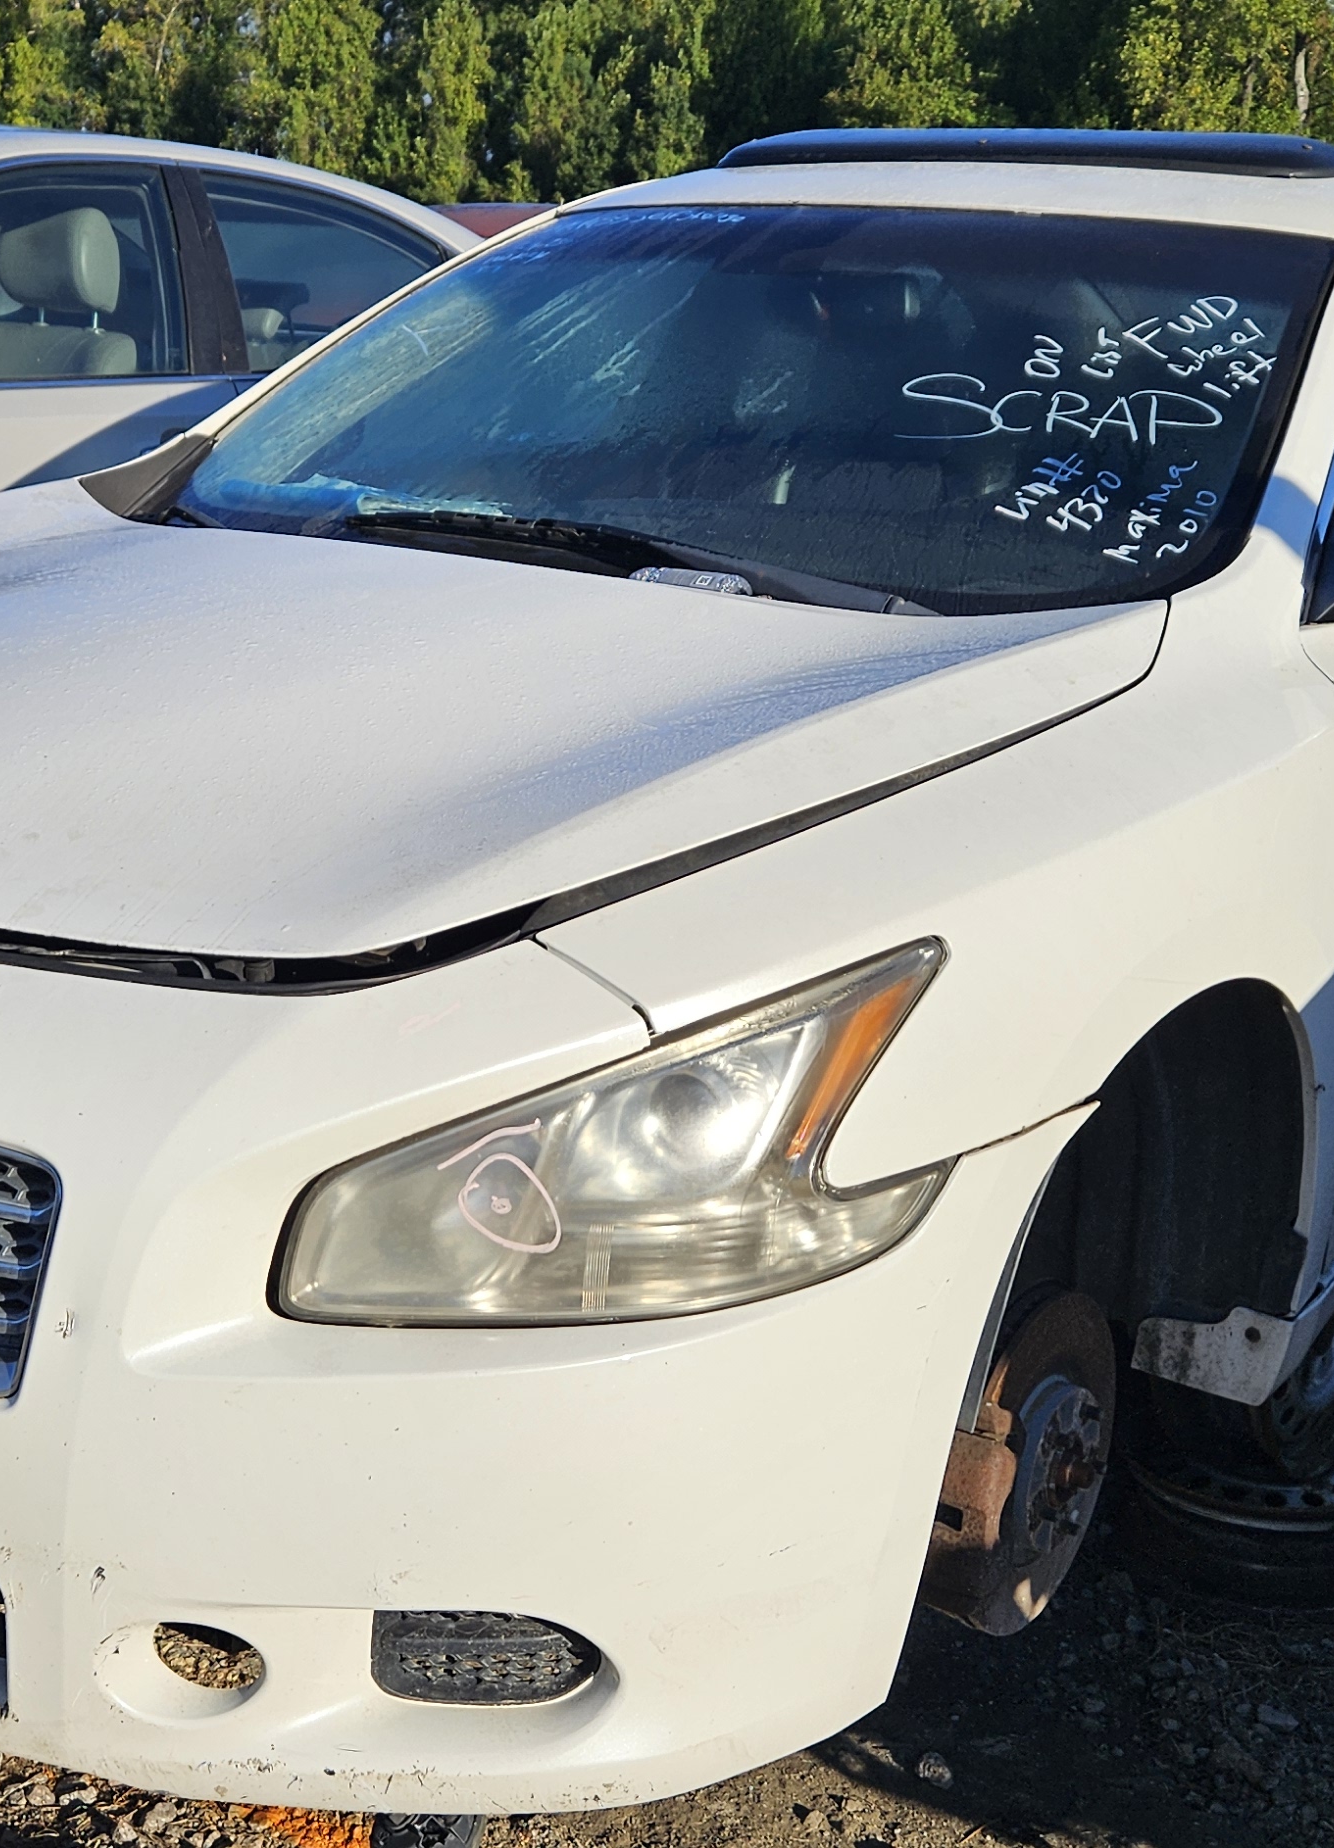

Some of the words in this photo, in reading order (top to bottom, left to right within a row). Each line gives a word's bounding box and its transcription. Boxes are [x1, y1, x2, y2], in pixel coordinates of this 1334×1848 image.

[1024, 335, 1064, 378] ON
[1122, 295, 1238, 358] FWD
[894, 372, 1223, 445] SCRAP
[1156, 490, 1218, 559] 2010
